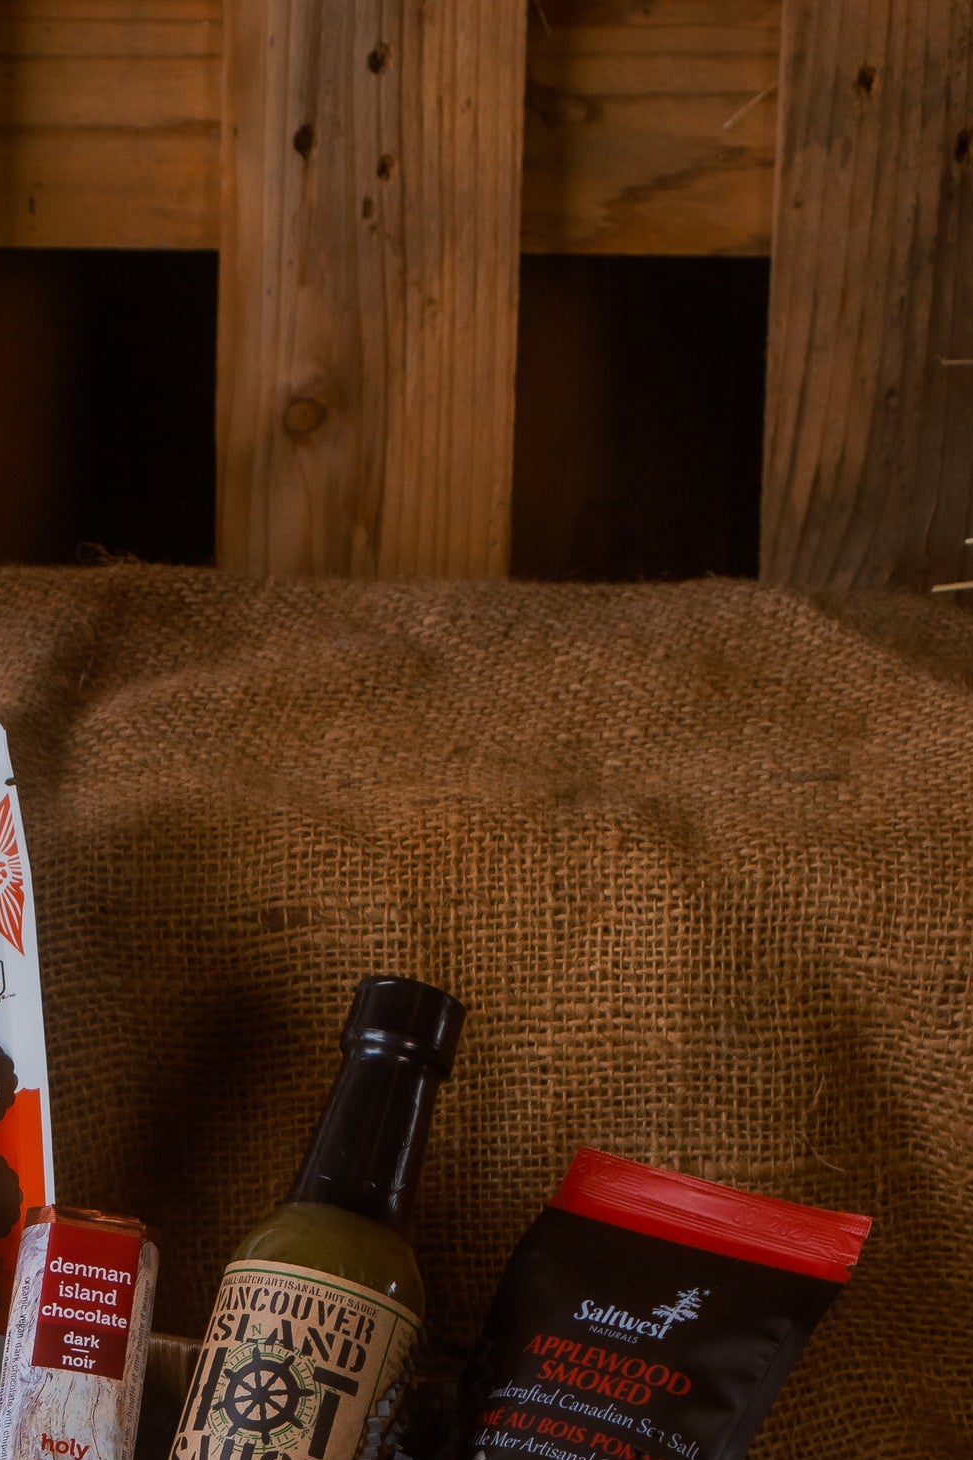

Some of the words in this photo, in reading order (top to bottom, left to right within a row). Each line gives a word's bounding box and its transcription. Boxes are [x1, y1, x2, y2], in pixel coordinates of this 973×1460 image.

[49, 1257, 131, 1285] denman
[21, 1276, 31, 1310] organic
[58, 1281, 117, 1306] island
[265, 1276, 322, 1297] ARTISANAL
[325, 1290, 346, 1304] HOT
[347, 1298, 380, 1318] SAUCE
[16, 1314, 27, 1339] vegan
[41, 1303, 127, 1328] chocolate
[216, 1286, 376, 1345] VANCOUVER
[63, 1331, 100, 1348] dark
[136, 1323, 145, 1351] pointe
[206, 1313, 368, 1374] ISLAND
[588, 1324, 639, 1344] NATURALS
[12, 1342, 23, 1362] dark
[62, 1354, 96, 1369] noir
[523, 1334, 692, 1396] APPLEWOOD
[7, 1363, 19, 1407] chocolate
[536, 1360, 652, 1405] SMOKED
[3, 1409, 13, 1426] with
[559, 1393, 634, 1428] Canadian
[490, 1430, 521, 1450] Mer
[505, 1411, 535, 1430] AU
[536, 1418, 588, 1444] BOIS
[41, 1433, 90, 1460] holy
